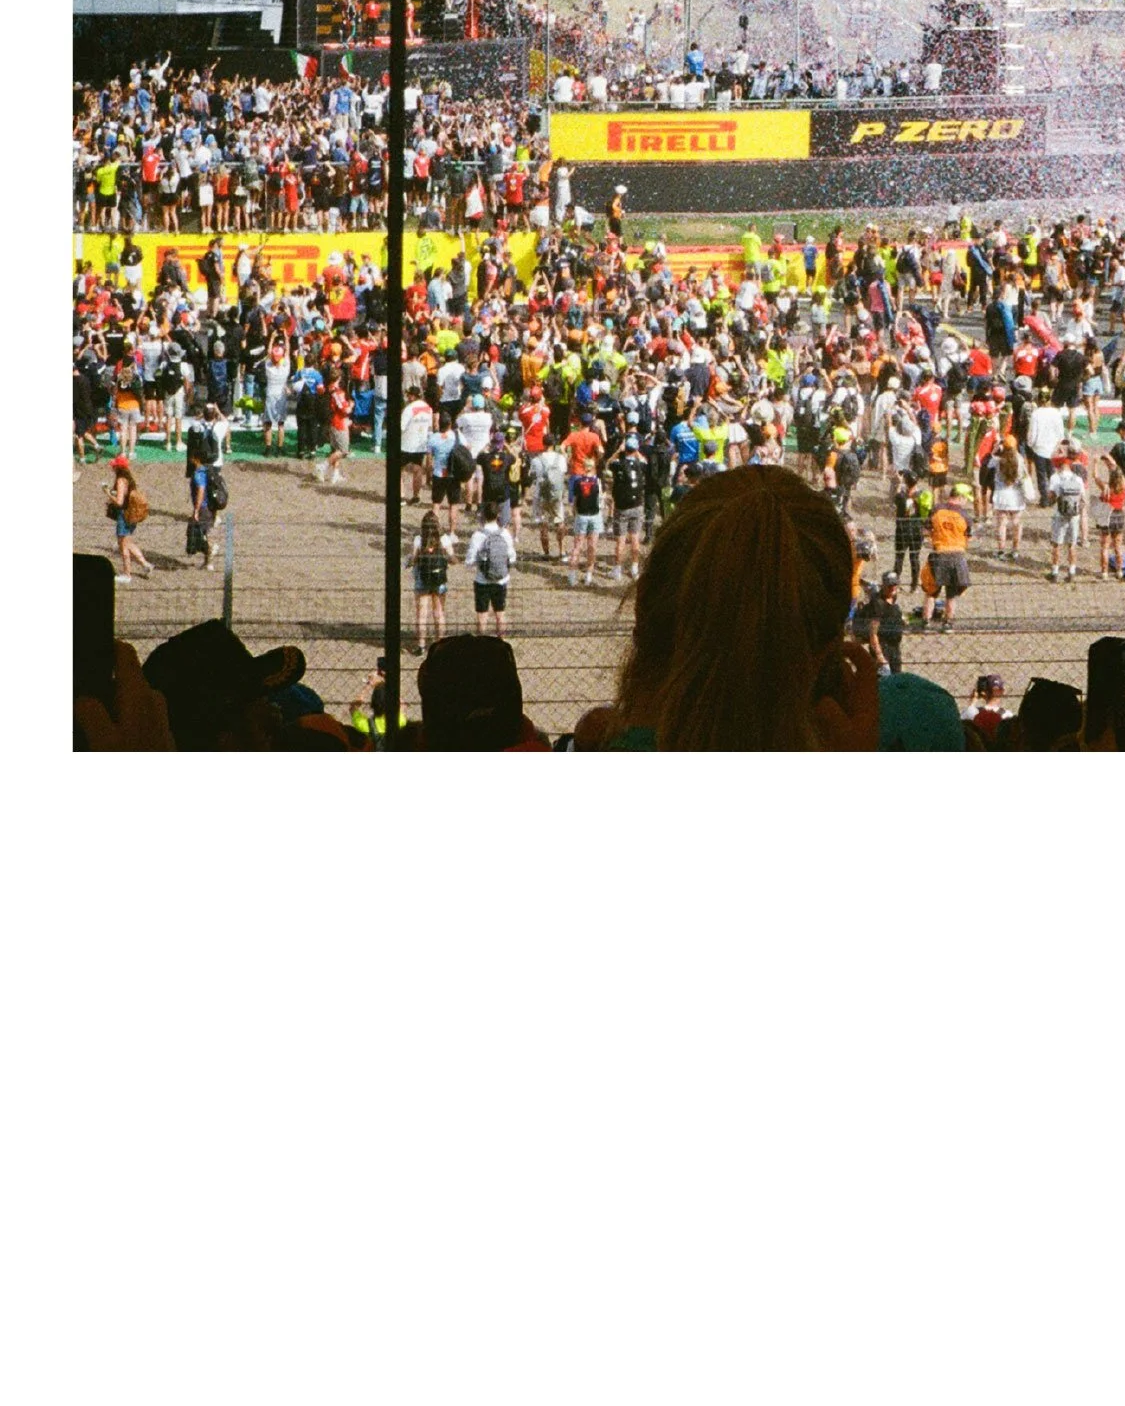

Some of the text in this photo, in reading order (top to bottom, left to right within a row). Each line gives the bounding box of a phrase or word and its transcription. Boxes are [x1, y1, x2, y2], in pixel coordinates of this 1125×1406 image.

[607, 120, 738, 152] PIRELLI
[850, 118, 1025, 144] P ZERO
